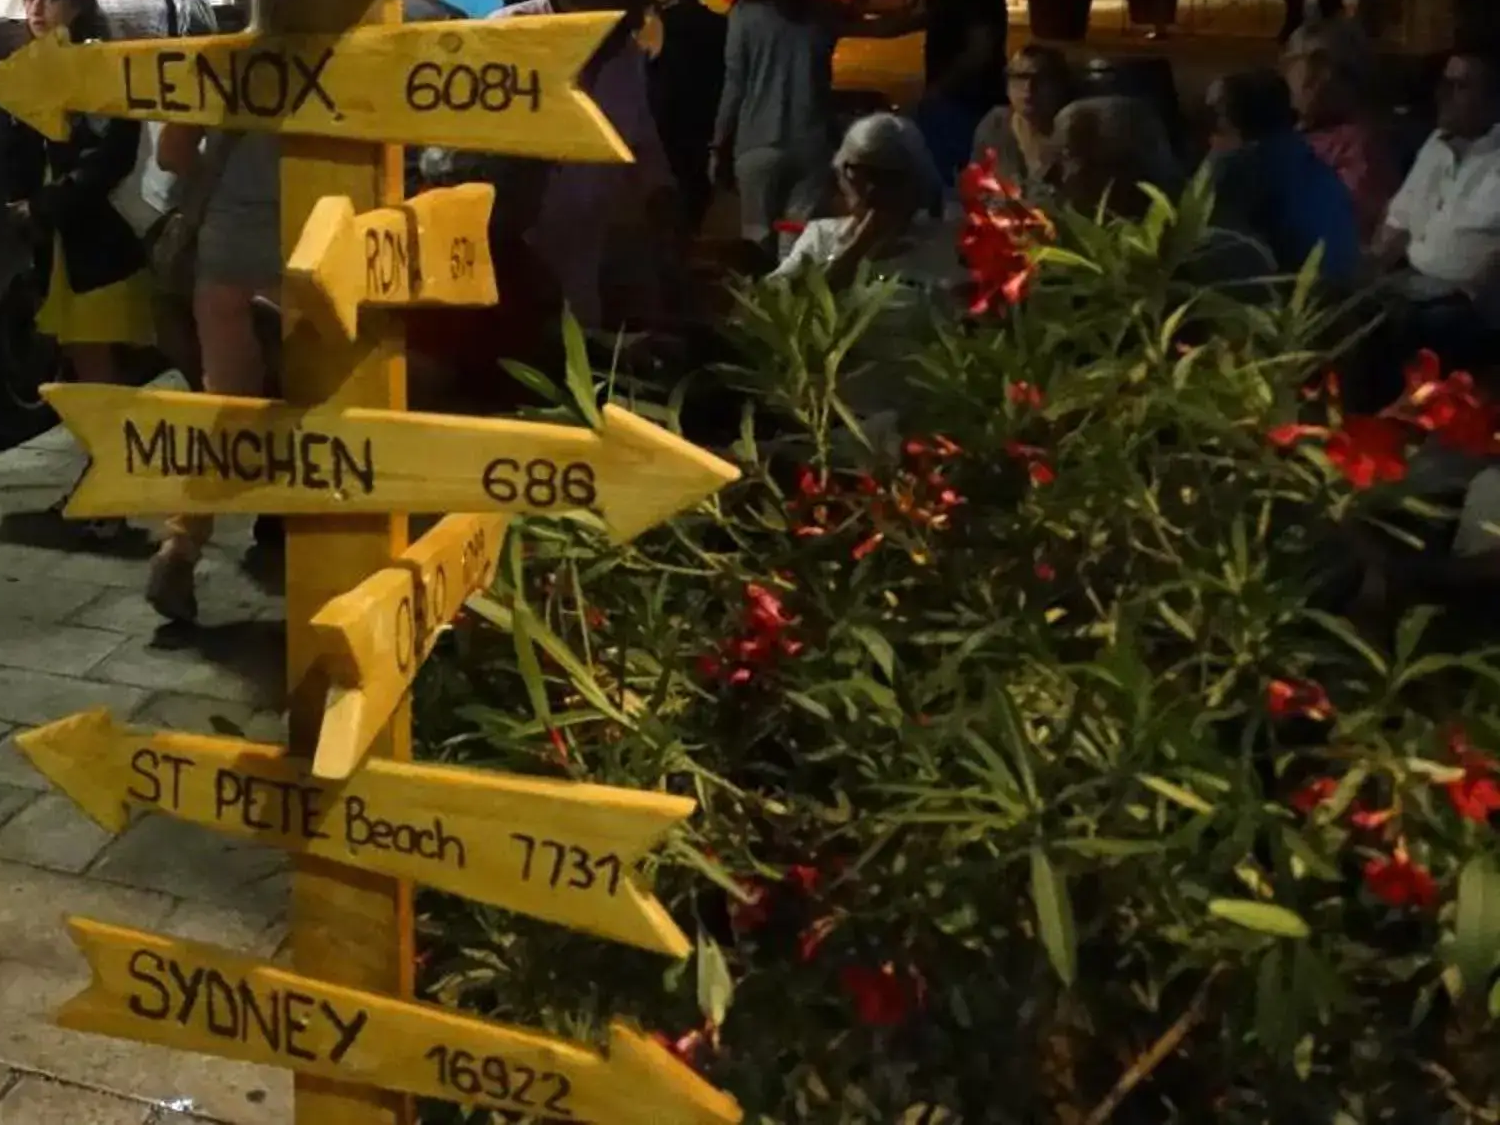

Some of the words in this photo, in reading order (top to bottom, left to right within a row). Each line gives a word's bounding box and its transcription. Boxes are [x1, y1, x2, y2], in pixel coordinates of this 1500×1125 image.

[122, 46, 336, 117] LENOX
[405, 61, 542, 113] 6084
[123, 418, 375, 494] MUNCHEN
[482, 457, 597, 508] 686
[127, 748, 196, 811] ST
[214, 767, 330, 840] PETE
[344, 794, 467, 870] Beach
[508, 831, 623, 898] 7731
[128, 949, 369, 1063] SYDNEY
[424, 1043, 572, 1117] 16922
